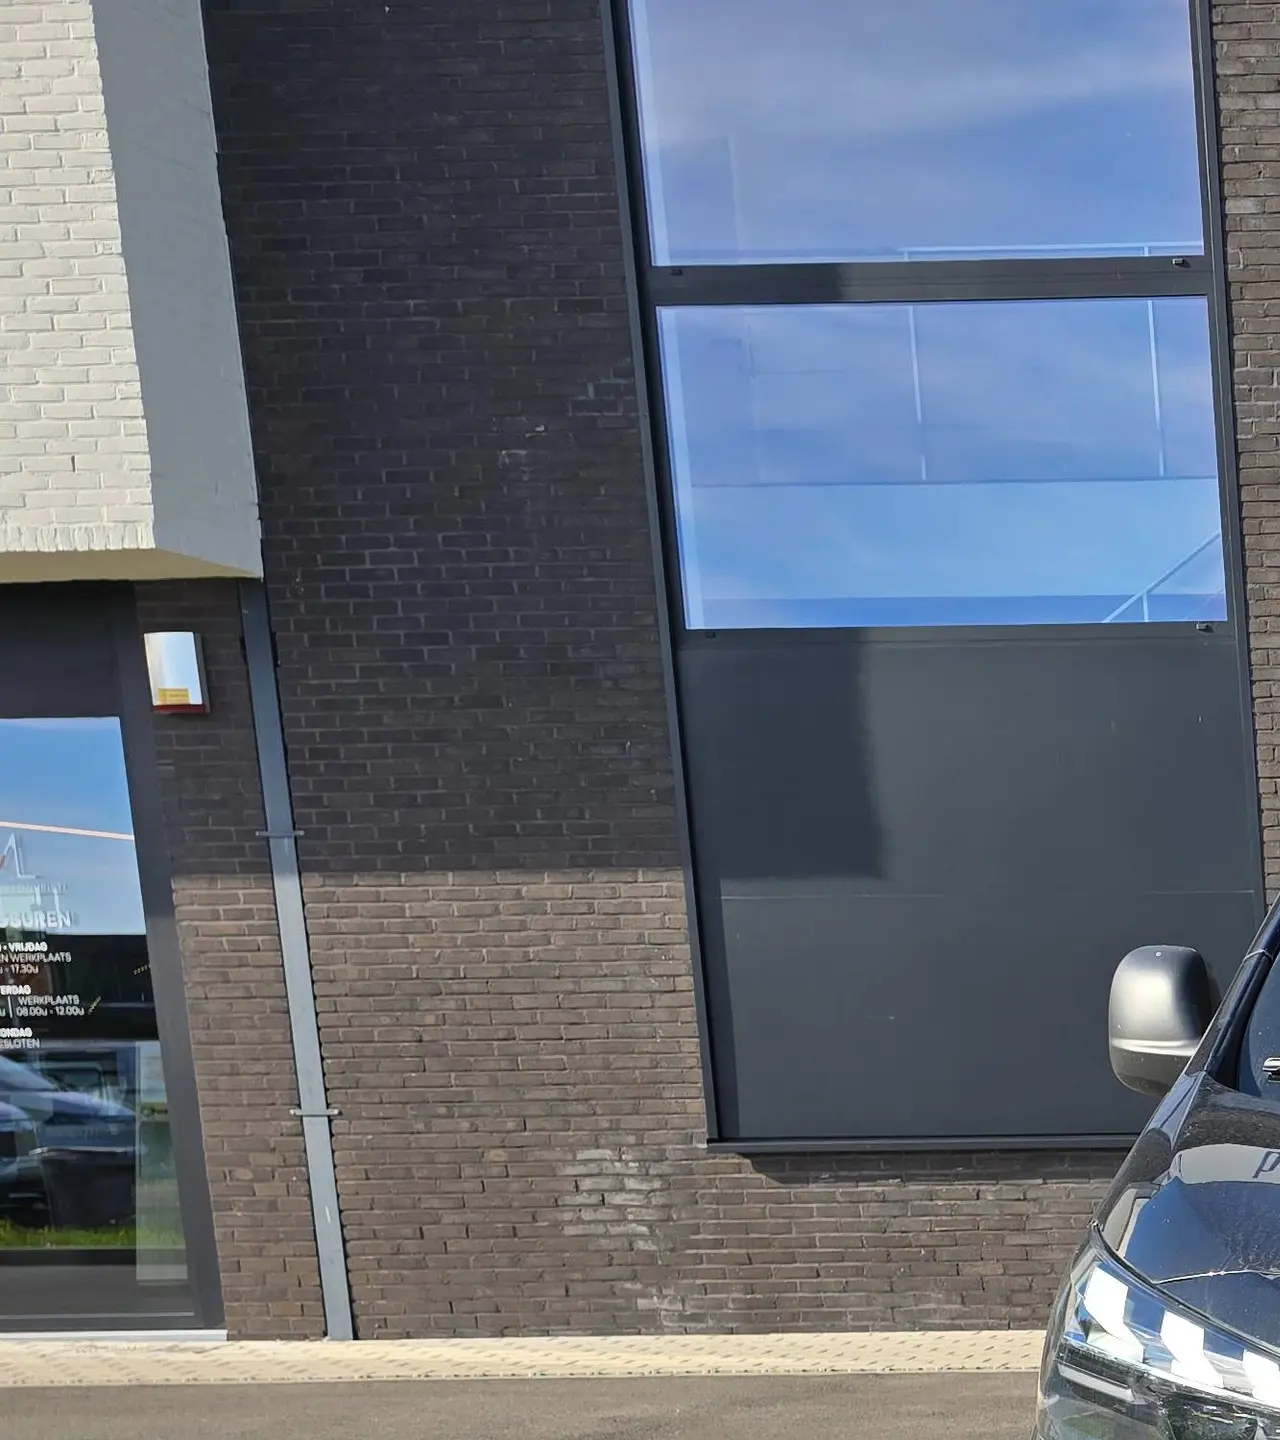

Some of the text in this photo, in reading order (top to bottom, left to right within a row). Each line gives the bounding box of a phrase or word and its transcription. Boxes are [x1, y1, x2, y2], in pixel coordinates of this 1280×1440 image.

[8, 941, 48, 952] VRIJDAG
[9, 951, 72, 962] WERKPLAATS
[0, 984, 32, 995] ERDAG
[18, 994, 80, 1005] WERKPLAATS
